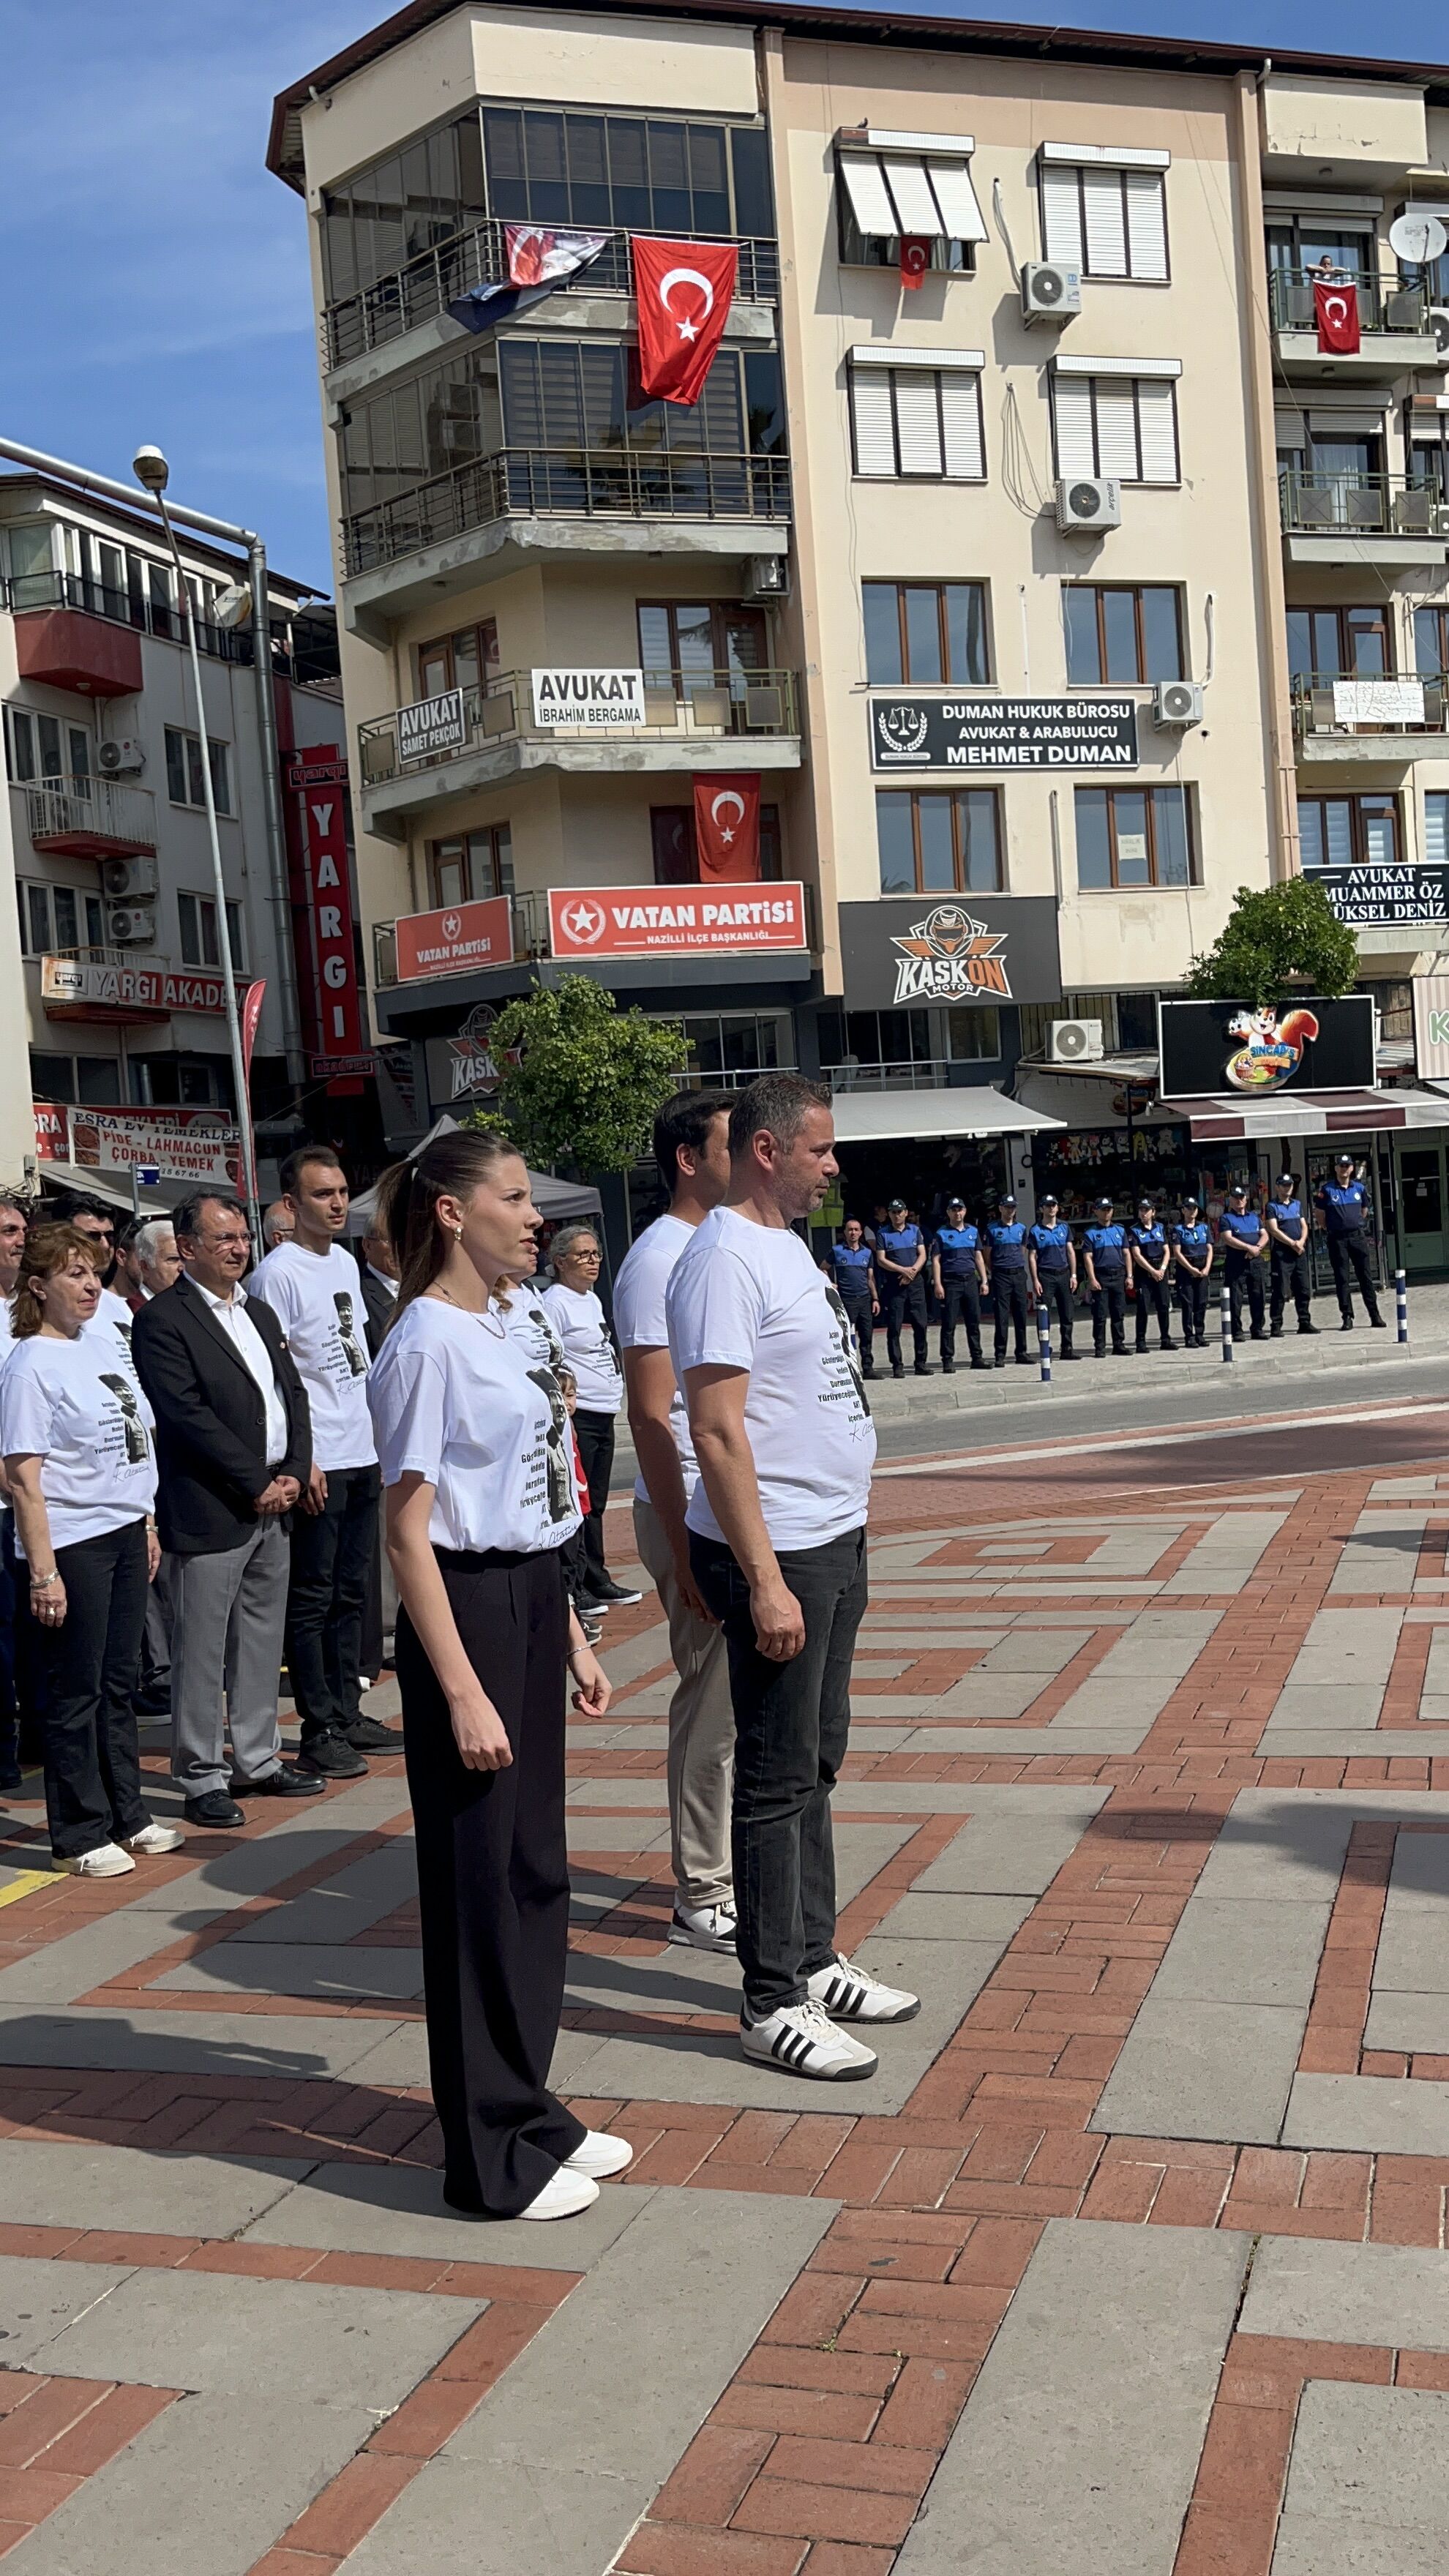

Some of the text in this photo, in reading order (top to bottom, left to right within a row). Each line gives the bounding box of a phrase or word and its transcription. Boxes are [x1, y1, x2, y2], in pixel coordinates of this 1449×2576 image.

[539, 675, 637, 701] AVUKAT
[401, 694, 458, 738] AVUKAT
[539, 704, 641, 722] İBRAHİM BERGAMA
[943, 701, 1130, 719] DUMAN HUKUK BÜROSU
[402, 722, 460, 756] SAMET PEKÇOK
[959, 726, 1117, 739] AVUKAT & ARABULUCU
[947, 745, 1131, 763] MEHMET DUMAN
[1347, 867, 1416, 884] AVUKAT
[1326, 881, 1444, 902] MUAMMER ÖZ
[612, 905, 696, 929] VATAN
[1333, 899, 1446, 921] ÜKSEL DENİZ
[647, 930, 769, 945] NAZİLLİ İLÇE BAŞKANLIĞI
[416, 946, 450, 963] VATAN
[898, 959, 1007, 998] KASKON
[932, 983, 974, 994] MOTOR
[92, 971, 247, 1008] YARGI AKADEM
[454, 1055, 500, 1094] KASK
[75, 1112, 119, 1130] ESRA
[102, 1131, 132, 1146] PİDE
[147, 1137, 221, 1156] LAHMACUN
[112, 1147, 156, 1164] ÇORBA
[170, 1155, 214, 1172] YEMEK
